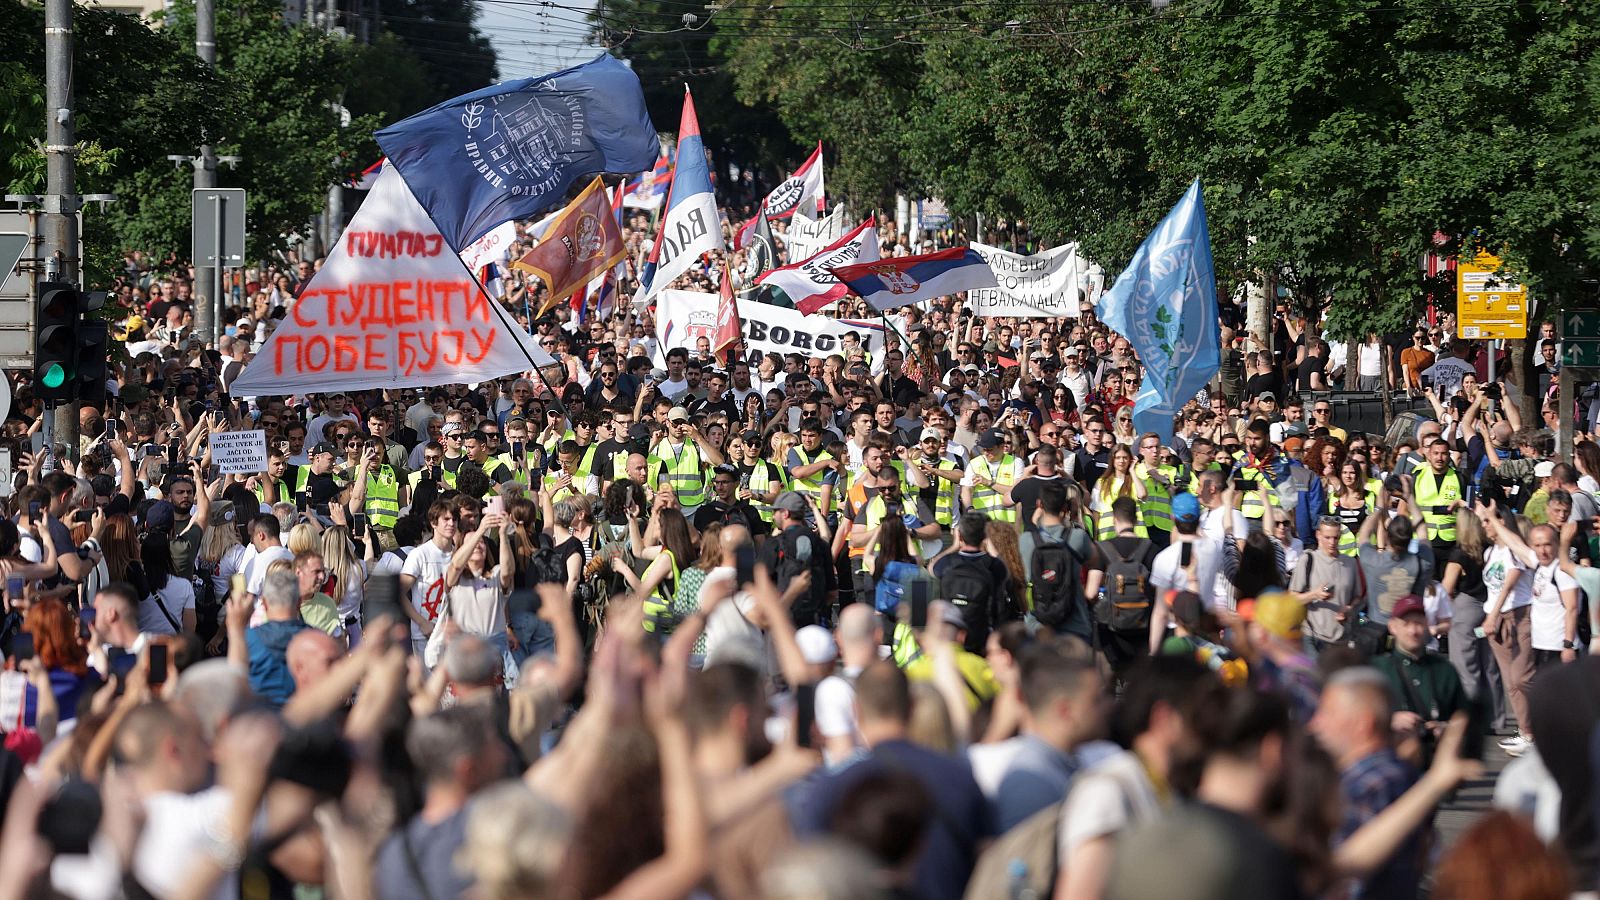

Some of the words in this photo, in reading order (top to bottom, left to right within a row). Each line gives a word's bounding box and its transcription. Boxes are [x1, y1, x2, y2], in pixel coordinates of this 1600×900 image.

[464, 141, 504, 188] ПРАВНИ
[346, 230, 445, 259] ПУМПАЈ
[995, 272, 1051, 290] РОТИВ
[292, 278, 491, 331] СТУДЕНТИ
[971, 289, 1067, 310] НЕВАЉАЛАЦА
[274, 326, 497, 377] ПОБЕЂУЈУ
[217, 433, 240, 441] JEDAN
[222, 463, 258, 471] MORAJU!!!
